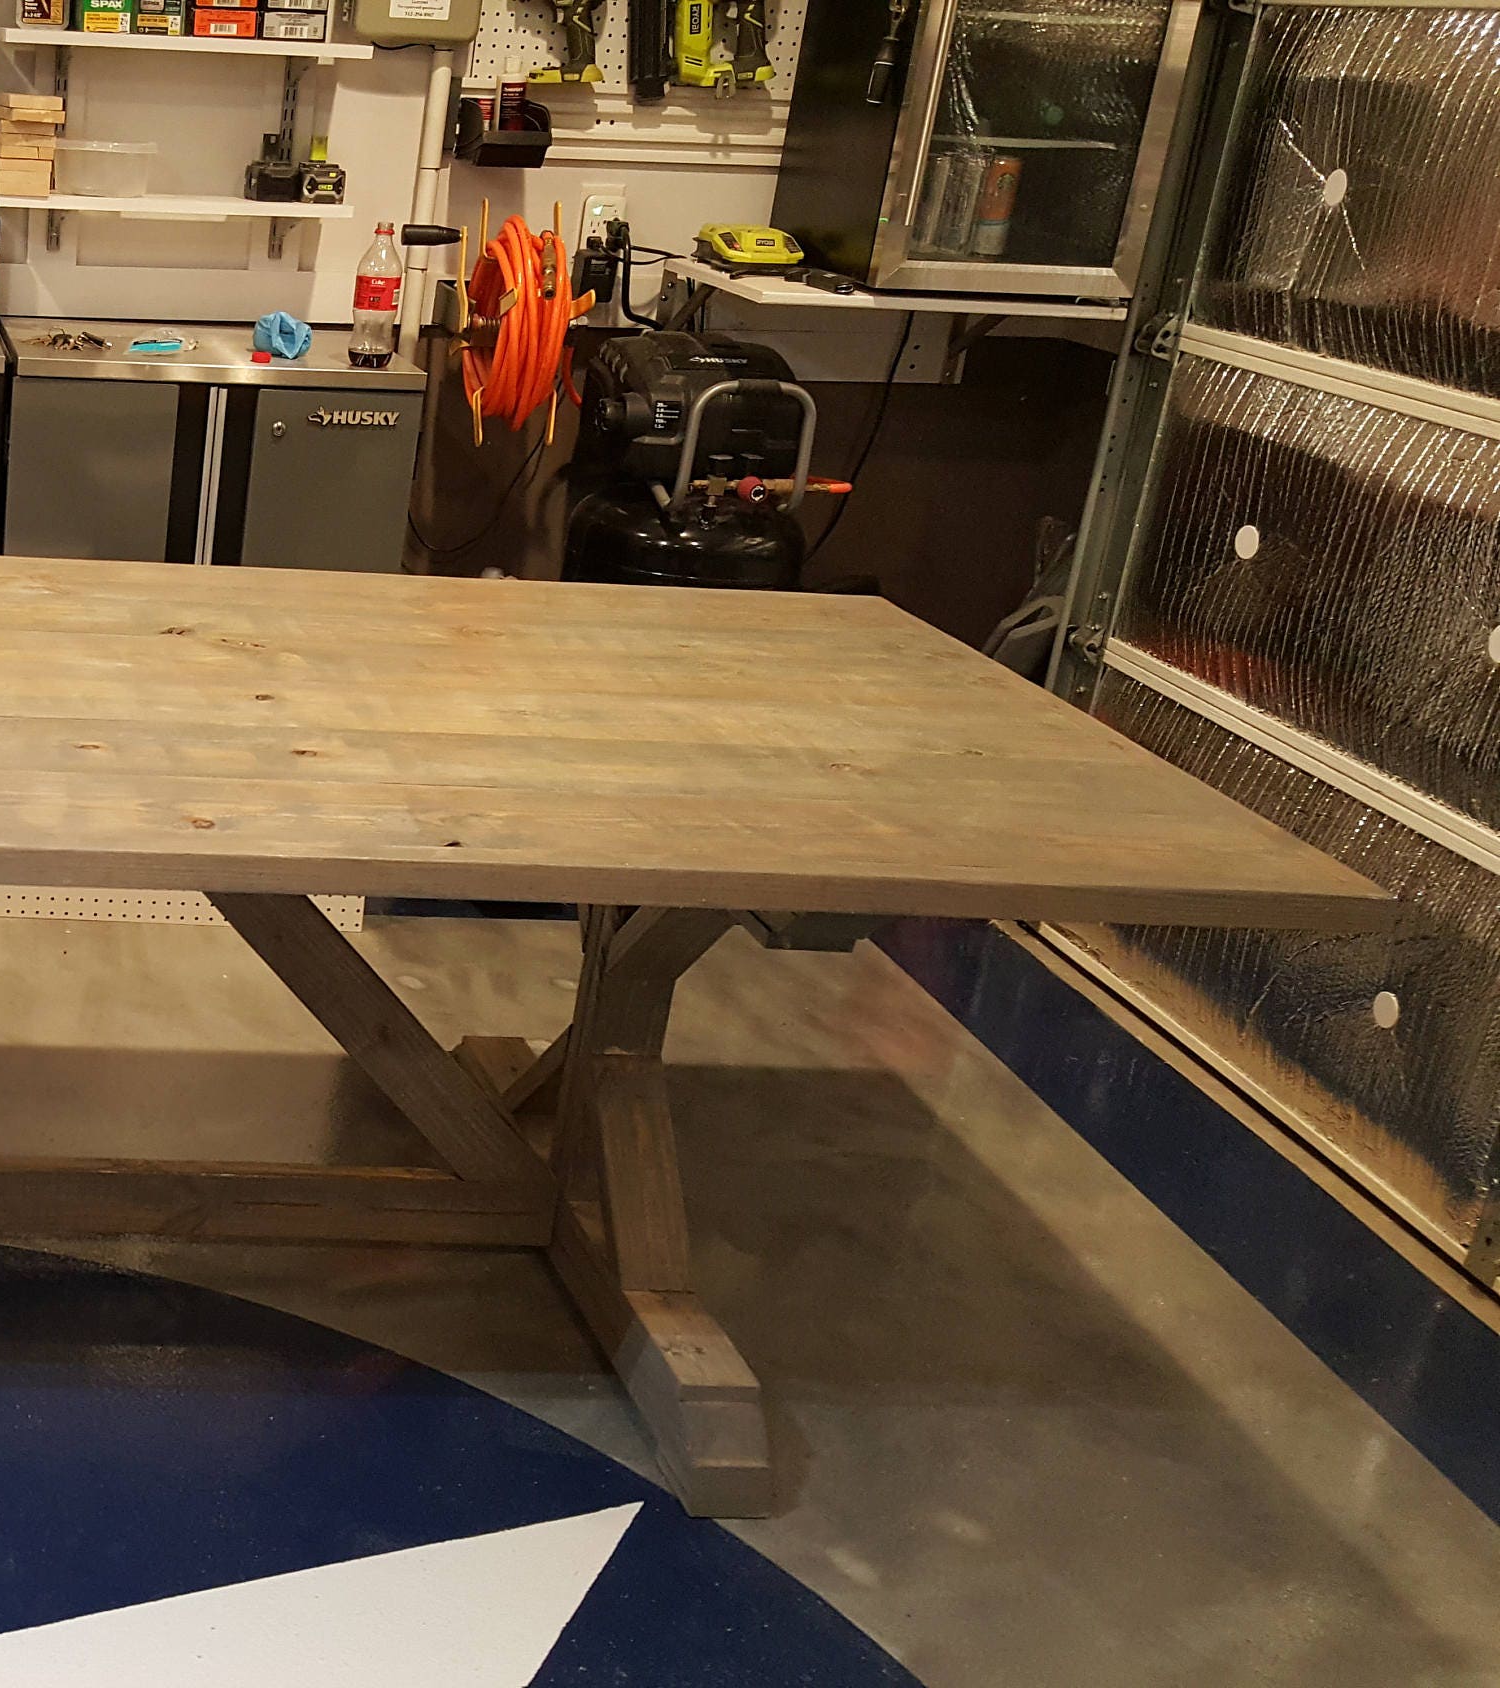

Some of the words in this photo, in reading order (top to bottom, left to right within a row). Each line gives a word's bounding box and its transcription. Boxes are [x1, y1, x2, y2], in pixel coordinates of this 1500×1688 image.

[90, 0, 123, 9] SPAX
[691, 5, 700, 33] RYOBI
[332, 410, 400, 426] HUSKY
